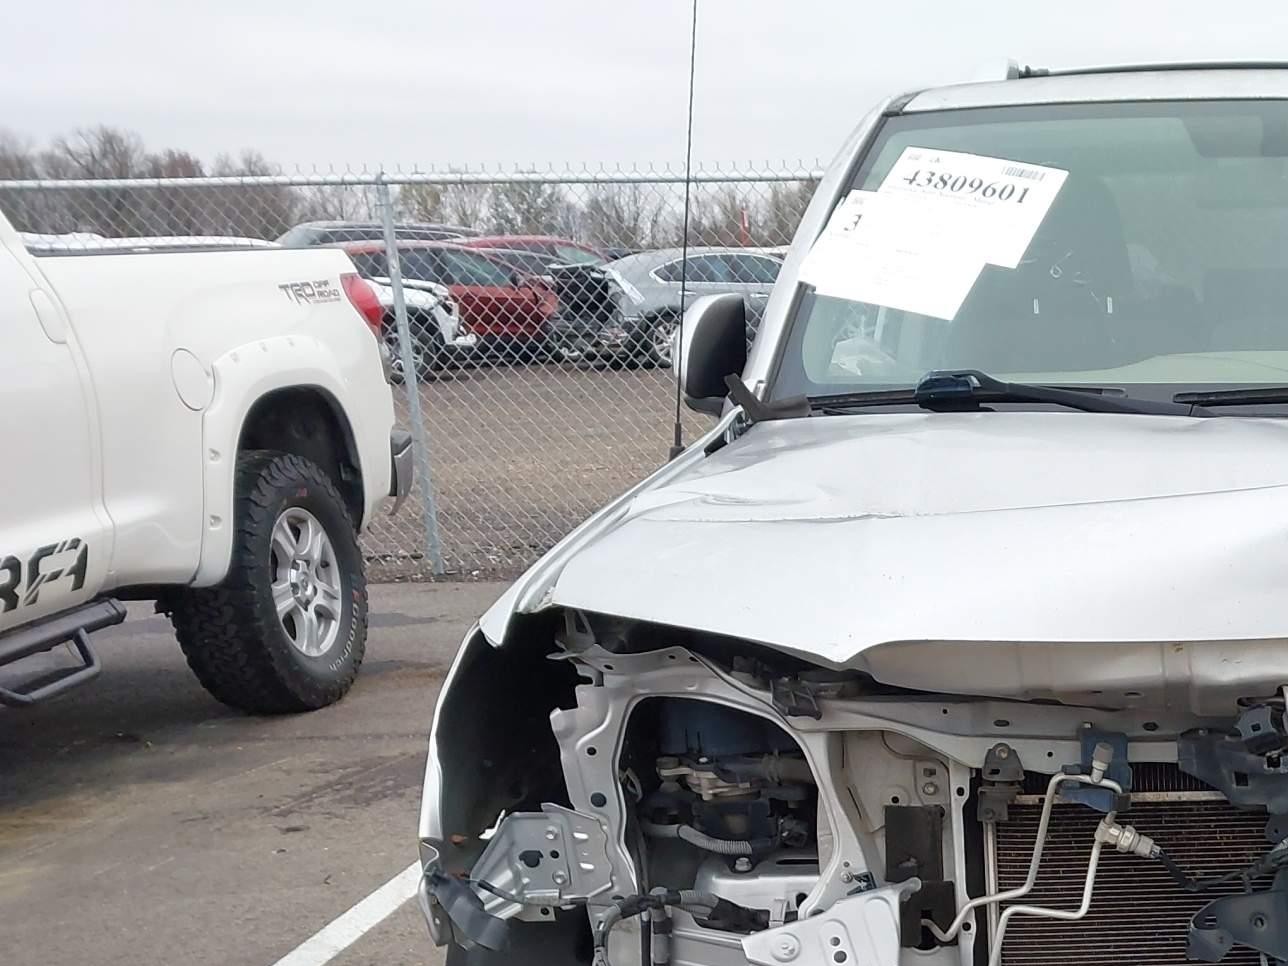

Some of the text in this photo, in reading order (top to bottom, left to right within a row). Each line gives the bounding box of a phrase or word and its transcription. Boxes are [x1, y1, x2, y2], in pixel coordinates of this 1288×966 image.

[903, 169, 1030, 204] 43809601
[278, 282, 316, 305] TRD
[317, 289, 340, 298] ROAD
